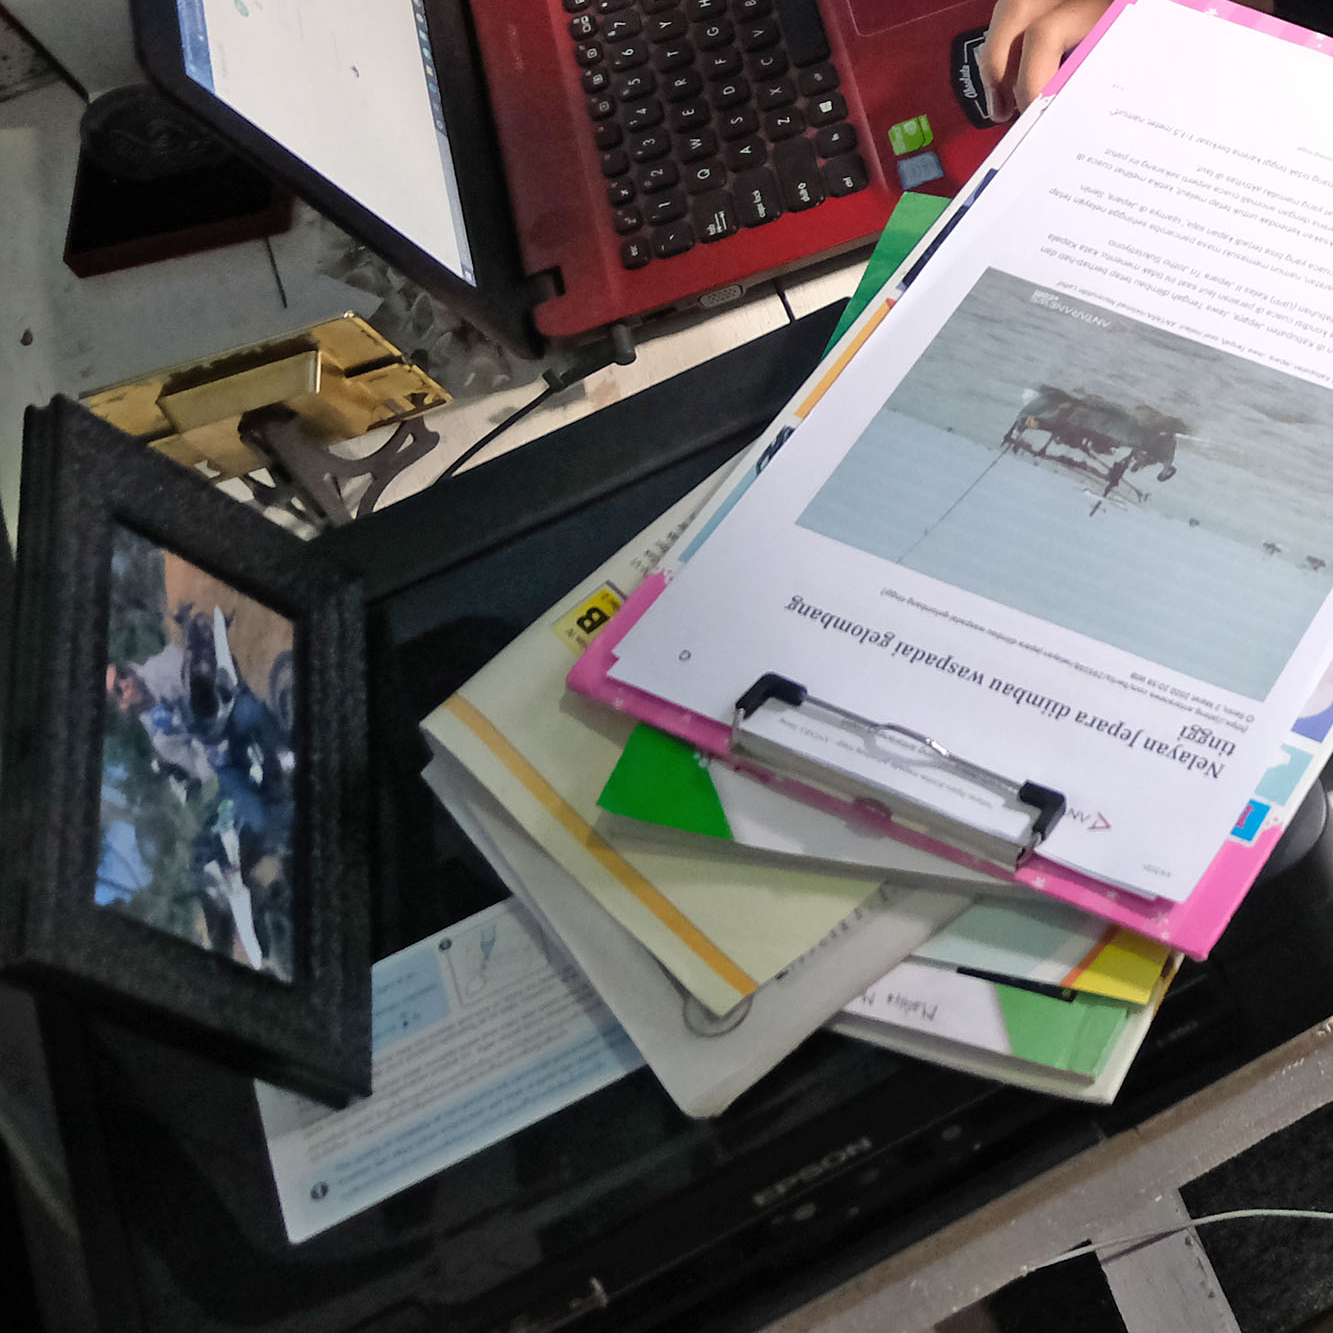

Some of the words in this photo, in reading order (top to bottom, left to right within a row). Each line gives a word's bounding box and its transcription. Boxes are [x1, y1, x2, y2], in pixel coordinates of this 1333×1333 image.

[658, 20, 672, 29] Y
[705, 25, 719, 37] G
[752, 29, 764, 37] V
[620, 47, 634, 56] 6
[759, 57, 774, 66] C
[626, 77, 641, 86] 5
[673, 77, 687, 87] R
[721, 85, 736, 95] D
[769, 86, 782, 95] X
[680, 108, 695, 116] E
[729, 115, 744, 125] S
[776, 115, 791, 125] Z
[641, 137, 656, 146] 3
[689, 137, 702, 150] W
[738, 144, 751, 154] A
[649, 167, 664, 177] 2
[695, 167, 710, 180] Q
[657, 200, 671, 208] 1
[575, 604, 610, 635] B
[779, 593, 898, 654] gelombang
[888, 635, 992, 690] waspadai
[982, 676, 1074, 723] diimbau
[1069, 704, 1145, 749] Jepara
[1172, 719, 1241, 763] tinggi
[1137, 731, 1228, 782] Nelayan
[751, 1134, 873, 1208] EPSON
